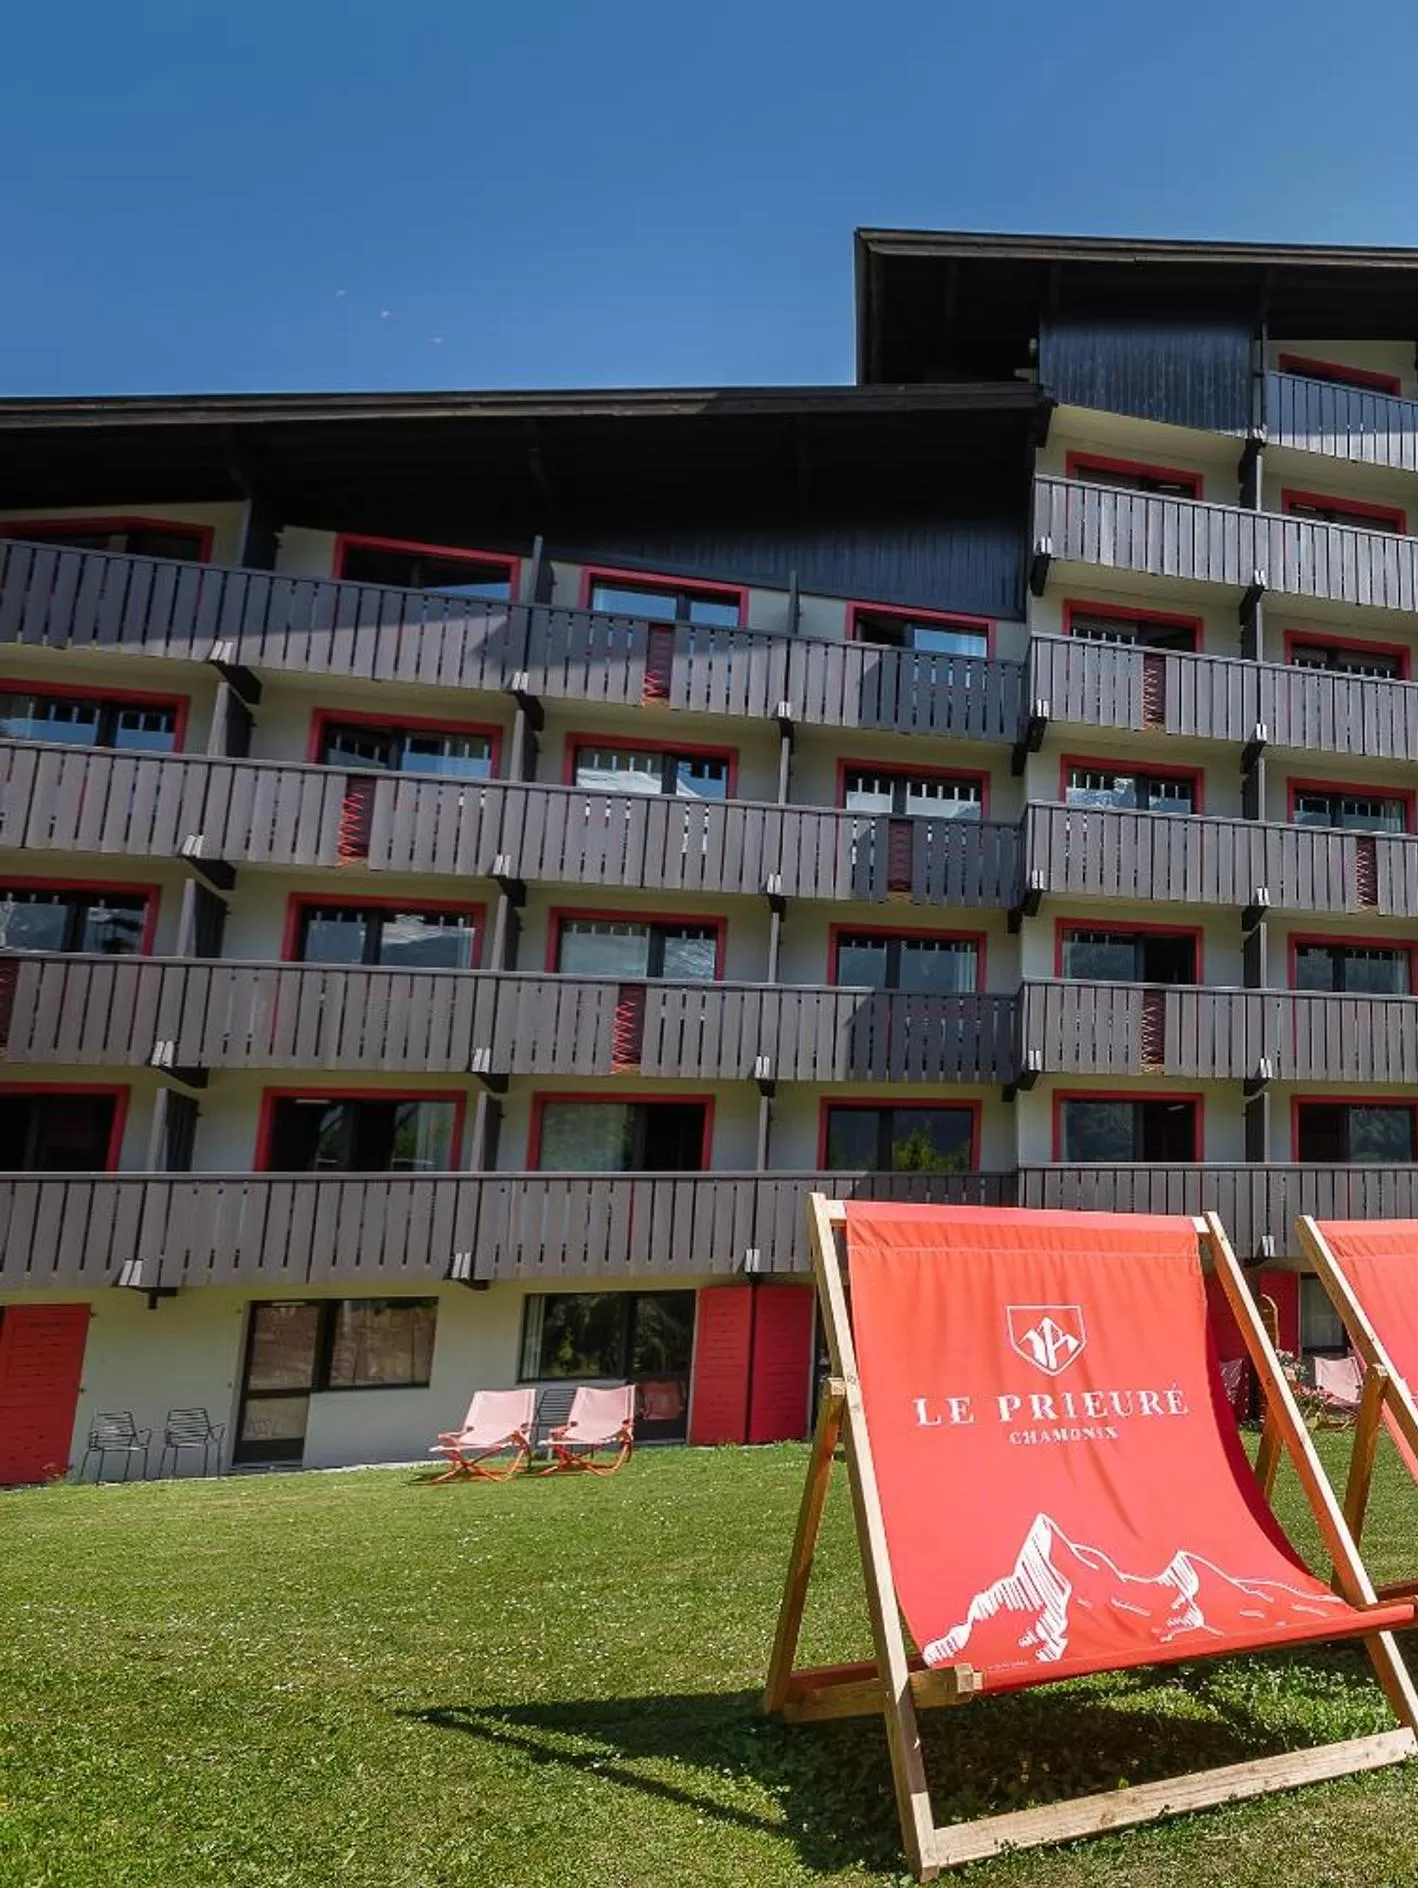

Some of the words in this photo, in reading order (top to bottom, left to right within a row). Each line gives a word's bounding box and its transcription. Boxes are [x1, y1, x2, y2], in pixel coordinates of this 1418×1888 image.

[912, 1397, 975, 1427] LE
[998, 1382, 1189, 1422] PRIEURÉ
[1009, 1427, 1119, 1445] CHAMONIX
